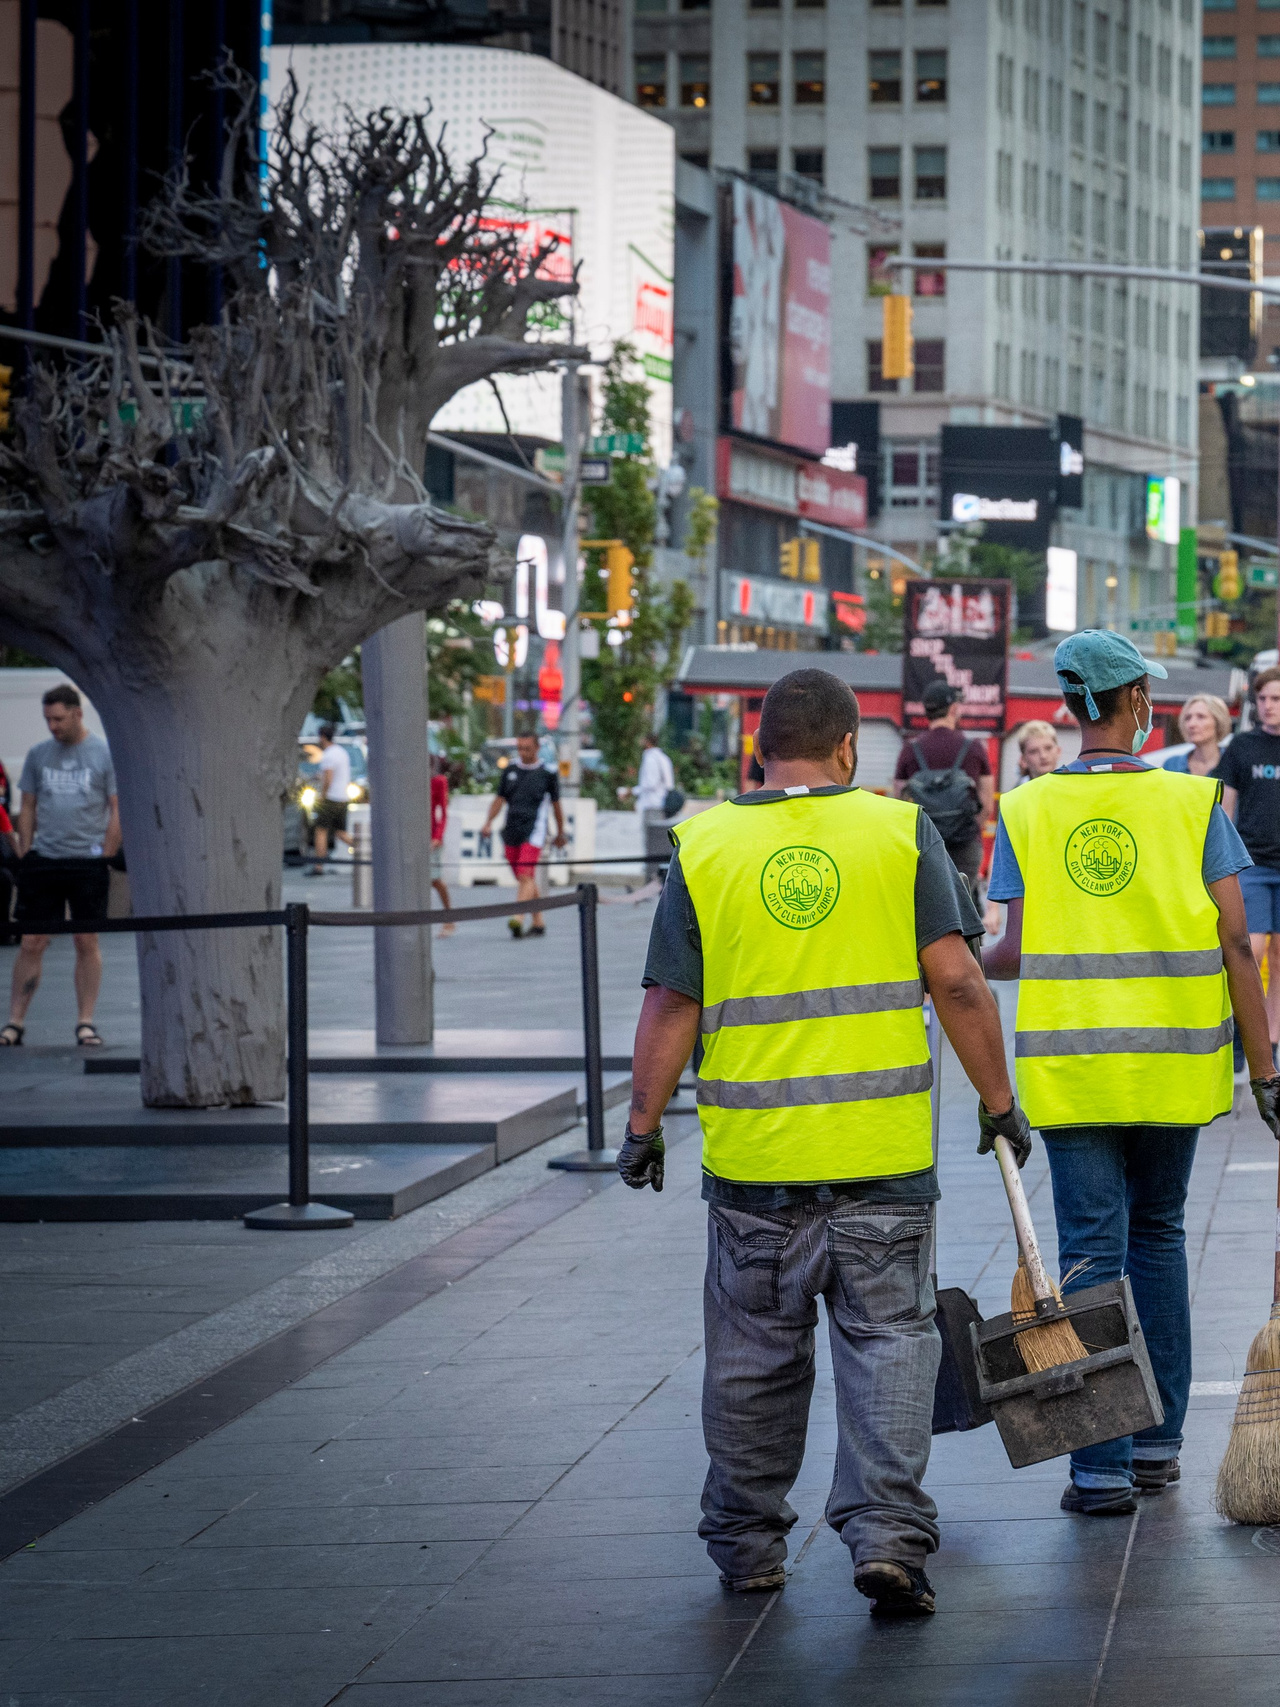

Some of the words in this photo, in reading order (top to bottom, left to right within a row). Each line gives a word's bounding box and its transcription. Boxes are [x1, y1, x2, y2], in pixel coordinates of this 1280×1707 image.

[1080, 824, 1098, 839] NEW
[1102, 823, 1124, 840] YORK
[775, 851, 795, 868] NEW
[798, 851, 822, 866] YORK
[1070, 860, 1084, 879] CITY
[1081, 876, 1115, 891] CLEANUP
[1114, 860, 1132, 886] CORPS
[767, 892, 783, 912] CITY
[780, 909, 816, 924] CLEANUP
[816, 886, 835, 915] CORPS
